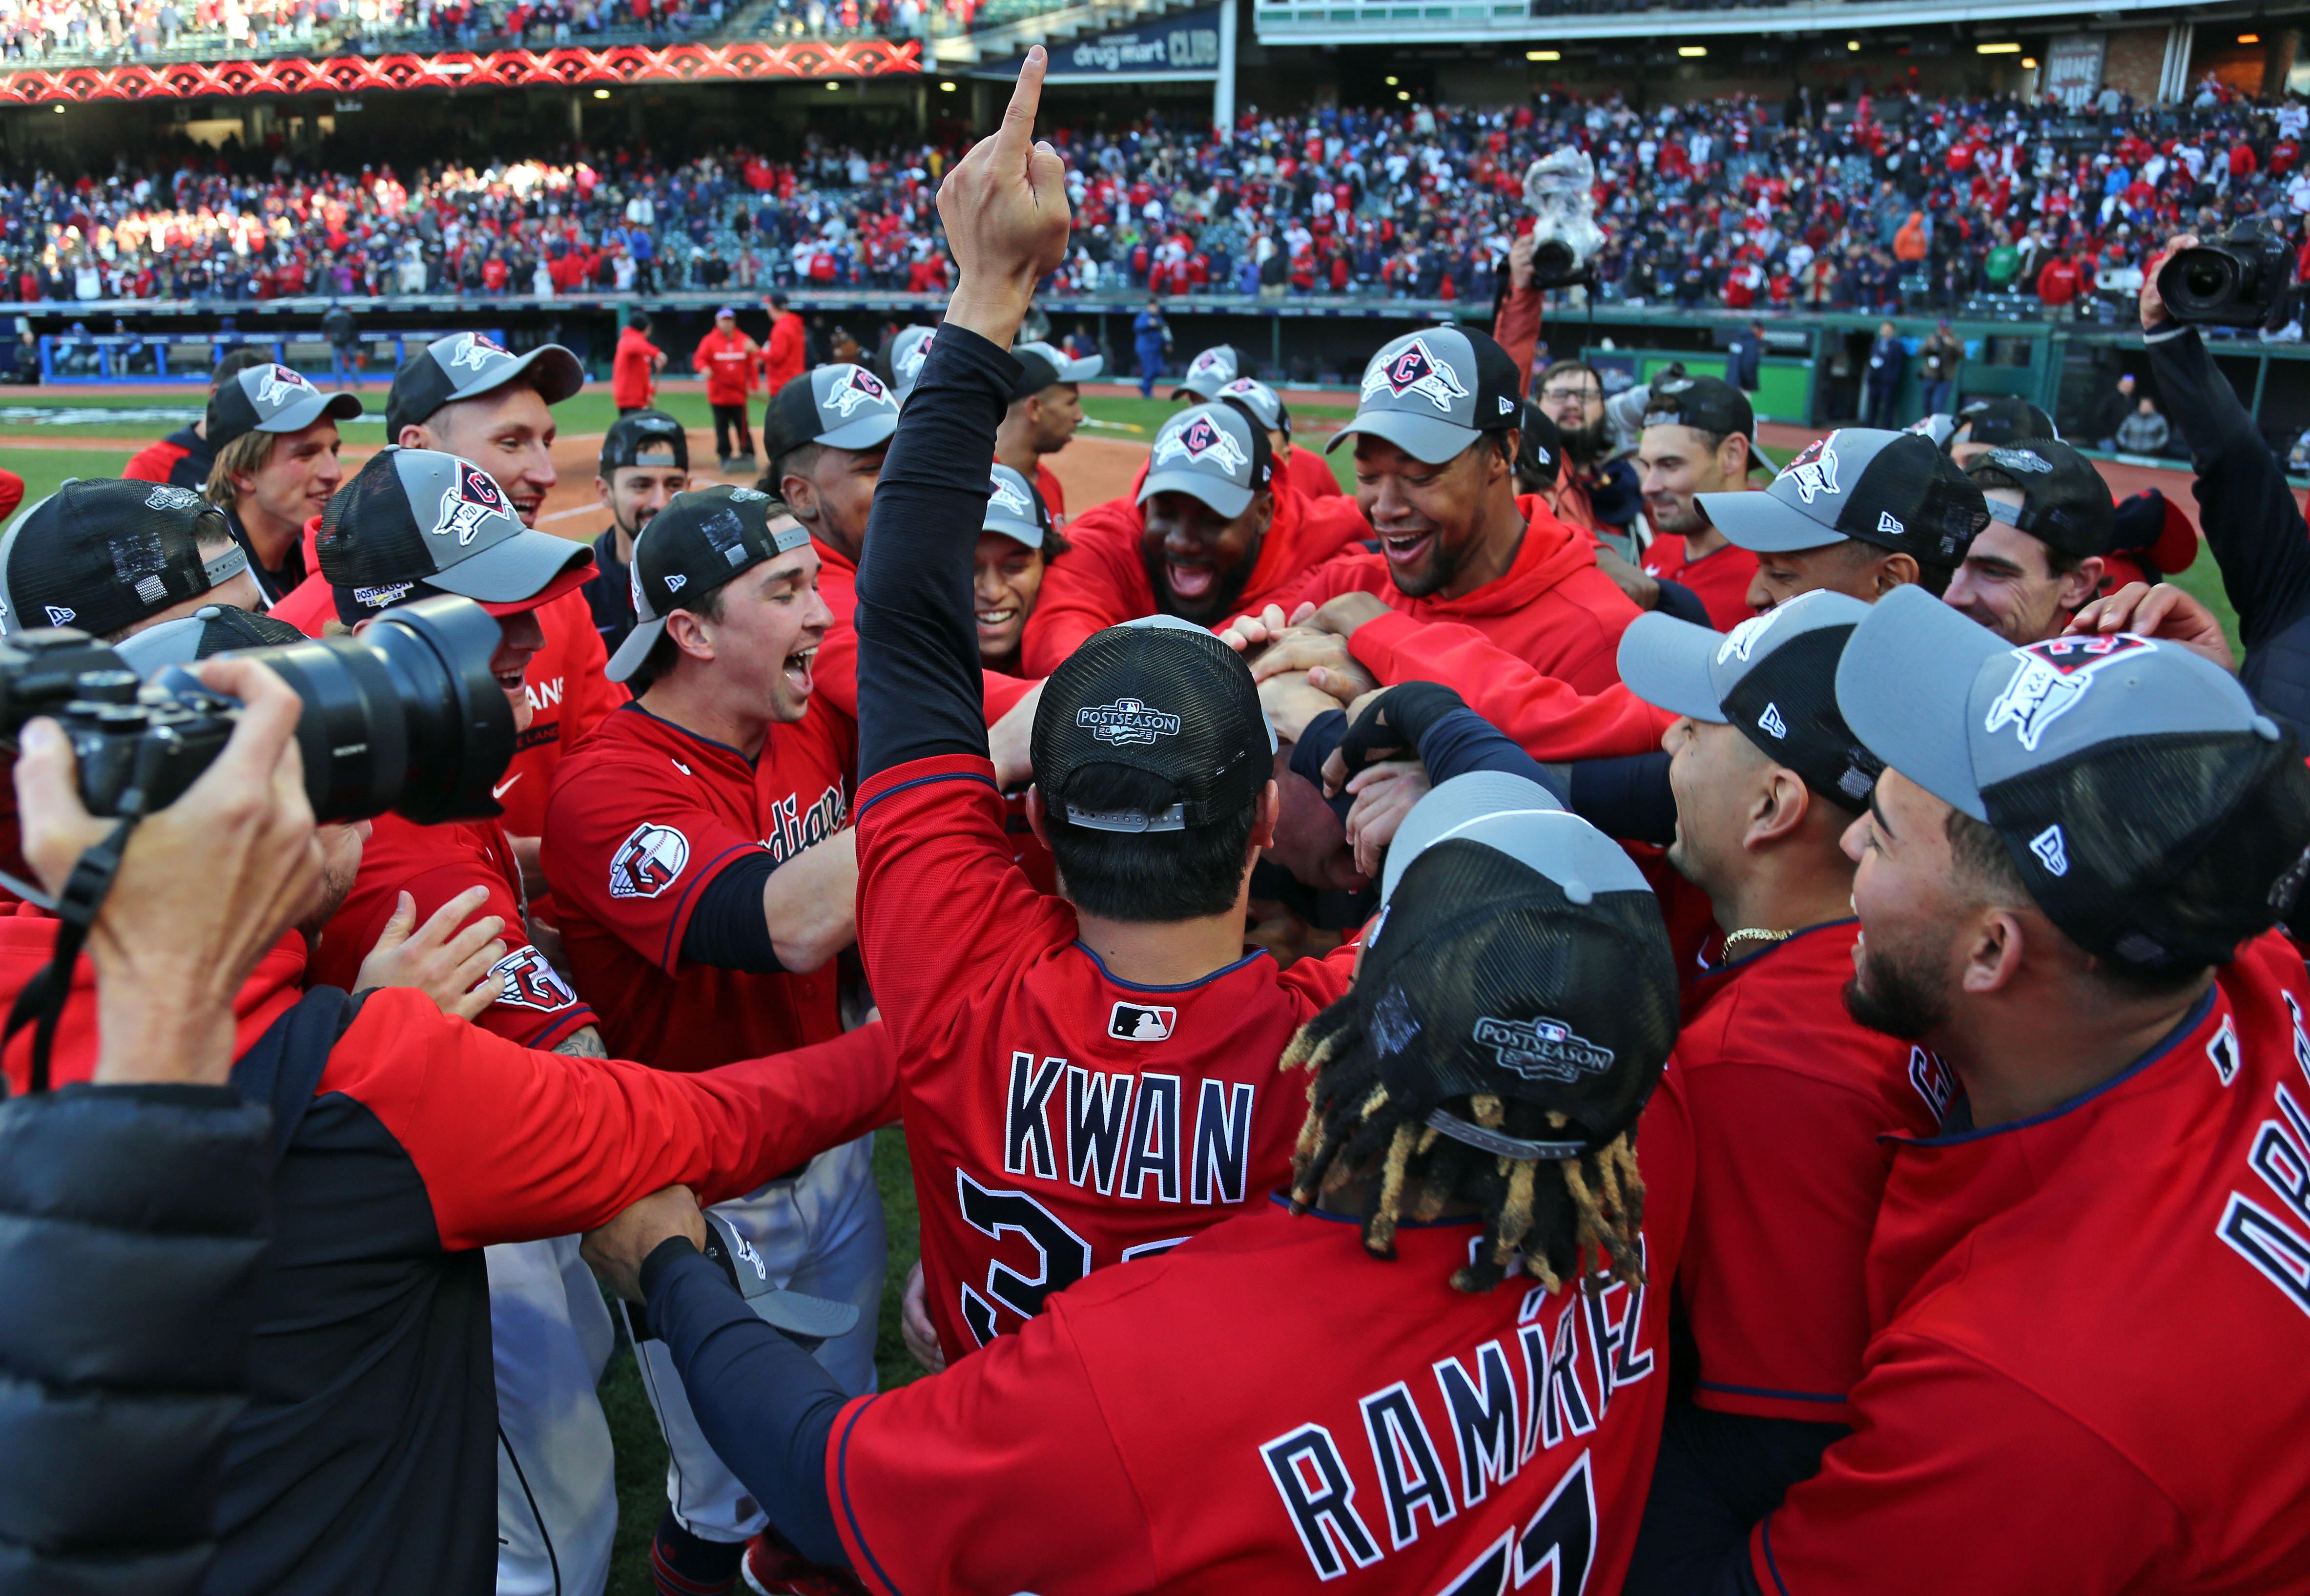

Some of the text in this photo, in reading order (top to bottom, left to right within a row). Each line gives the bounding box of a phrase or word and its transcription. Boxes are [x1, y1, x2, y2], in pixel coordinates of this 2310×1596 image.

[1072, 42, 1120, 71] drug
[1168, 29, 1217, 67] CLUB
[2051, 56, 2098, 83] HOME
[1392, 352, 1422, 383] C
[856, 372, 880, 394] C
[1424, 379, 1439, 388] 22
[1188, 423, 1211, 449] C
[467, 472, 497, 503] C
[462, 505, 478, 520] 20
[1081, 711, 1176, 731] POSTSEASON
[1481, 1024, 1608, 1070] POSTSEASON
[1005, 1051, 1255, 1204] KWAN
[956, 1167, 1193, 1348] 3
